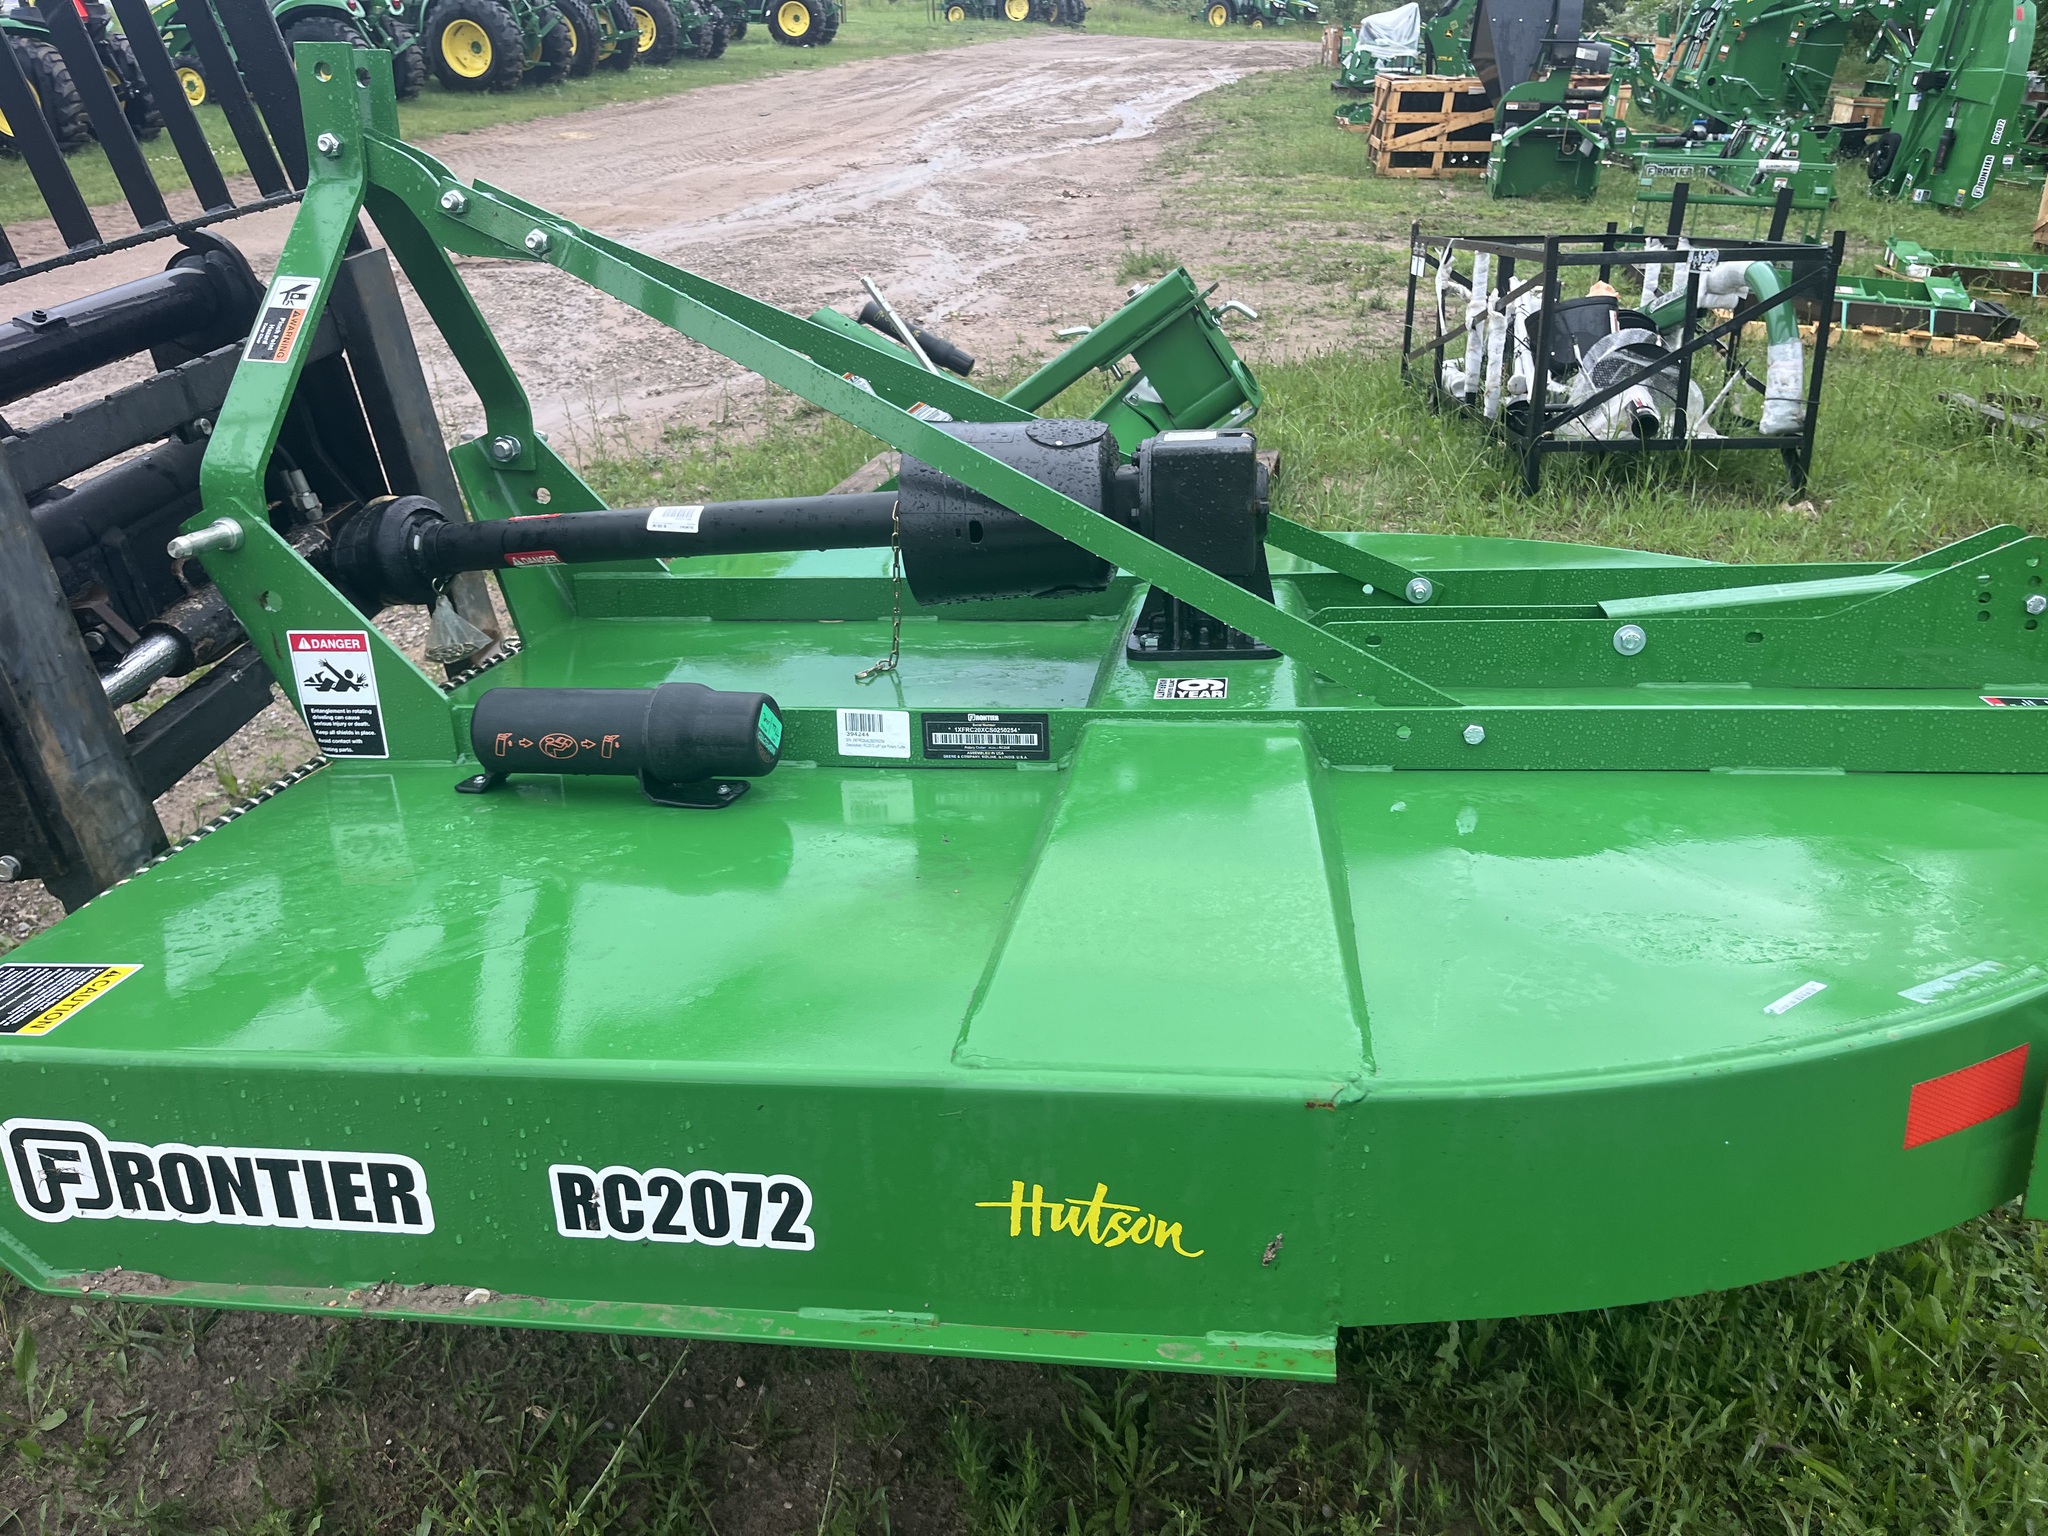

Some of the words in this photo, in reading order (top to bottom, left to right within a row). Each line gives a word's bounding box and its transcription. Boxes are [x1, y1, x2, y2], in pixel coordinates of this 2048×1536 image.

[1993, 120, 2005, 144] RC2072
[1973, 156, 1993, 197] FRONTIER
[262, 324, 275, 345] Hazard
[274, 317, 286, 334] Pinch
[267, 335, 280, 351] Point
[277, 319, 299, 358] WARNING
[522, 556, 559, 566] DANGER
[311, 639, 360, 649] DANGER
[968, 713, 999, 721] FRONTIER
[29, 979, 111, 1029] CAUTION
[9, 1128, 423, 1225] FRONTIER
[557, 1172, 806, 1243] RC2072
[975, 1180, 1204, 1258] Hutson
